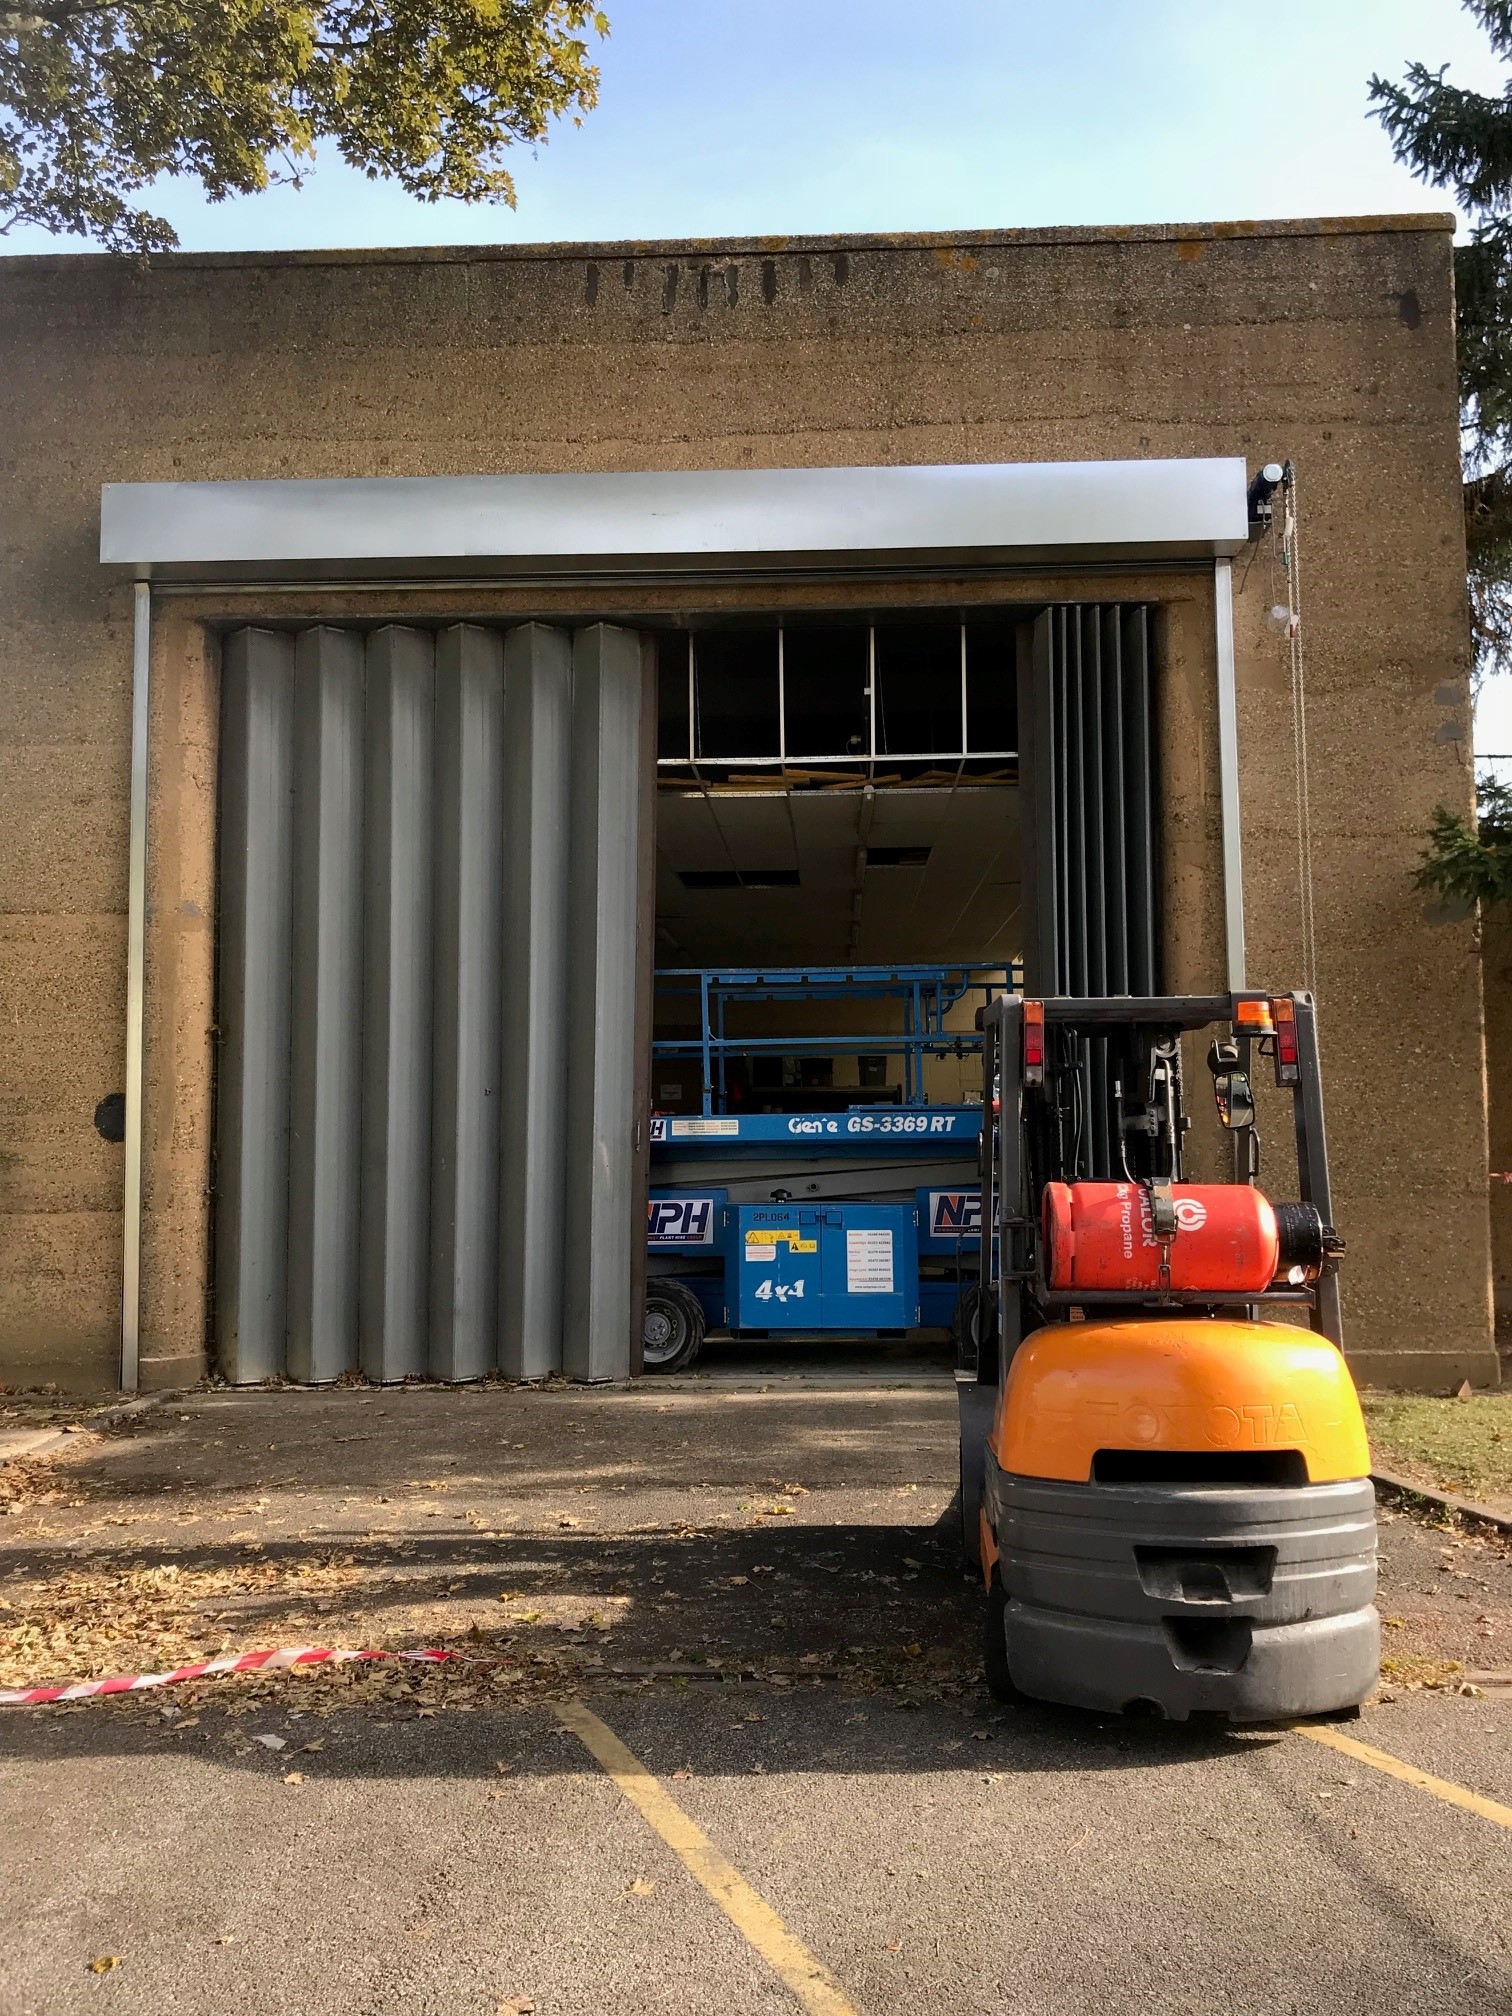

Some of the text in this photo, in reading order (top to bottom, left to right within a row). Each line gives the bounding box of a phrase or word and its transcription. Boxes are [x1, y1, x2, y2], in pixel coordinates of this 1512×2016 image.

[788, 1117, 838, 1133] Gene
[1120, 1202, 1133, 1259] Propane
[1086, 1401, 1308, 1447] TOYOTA
